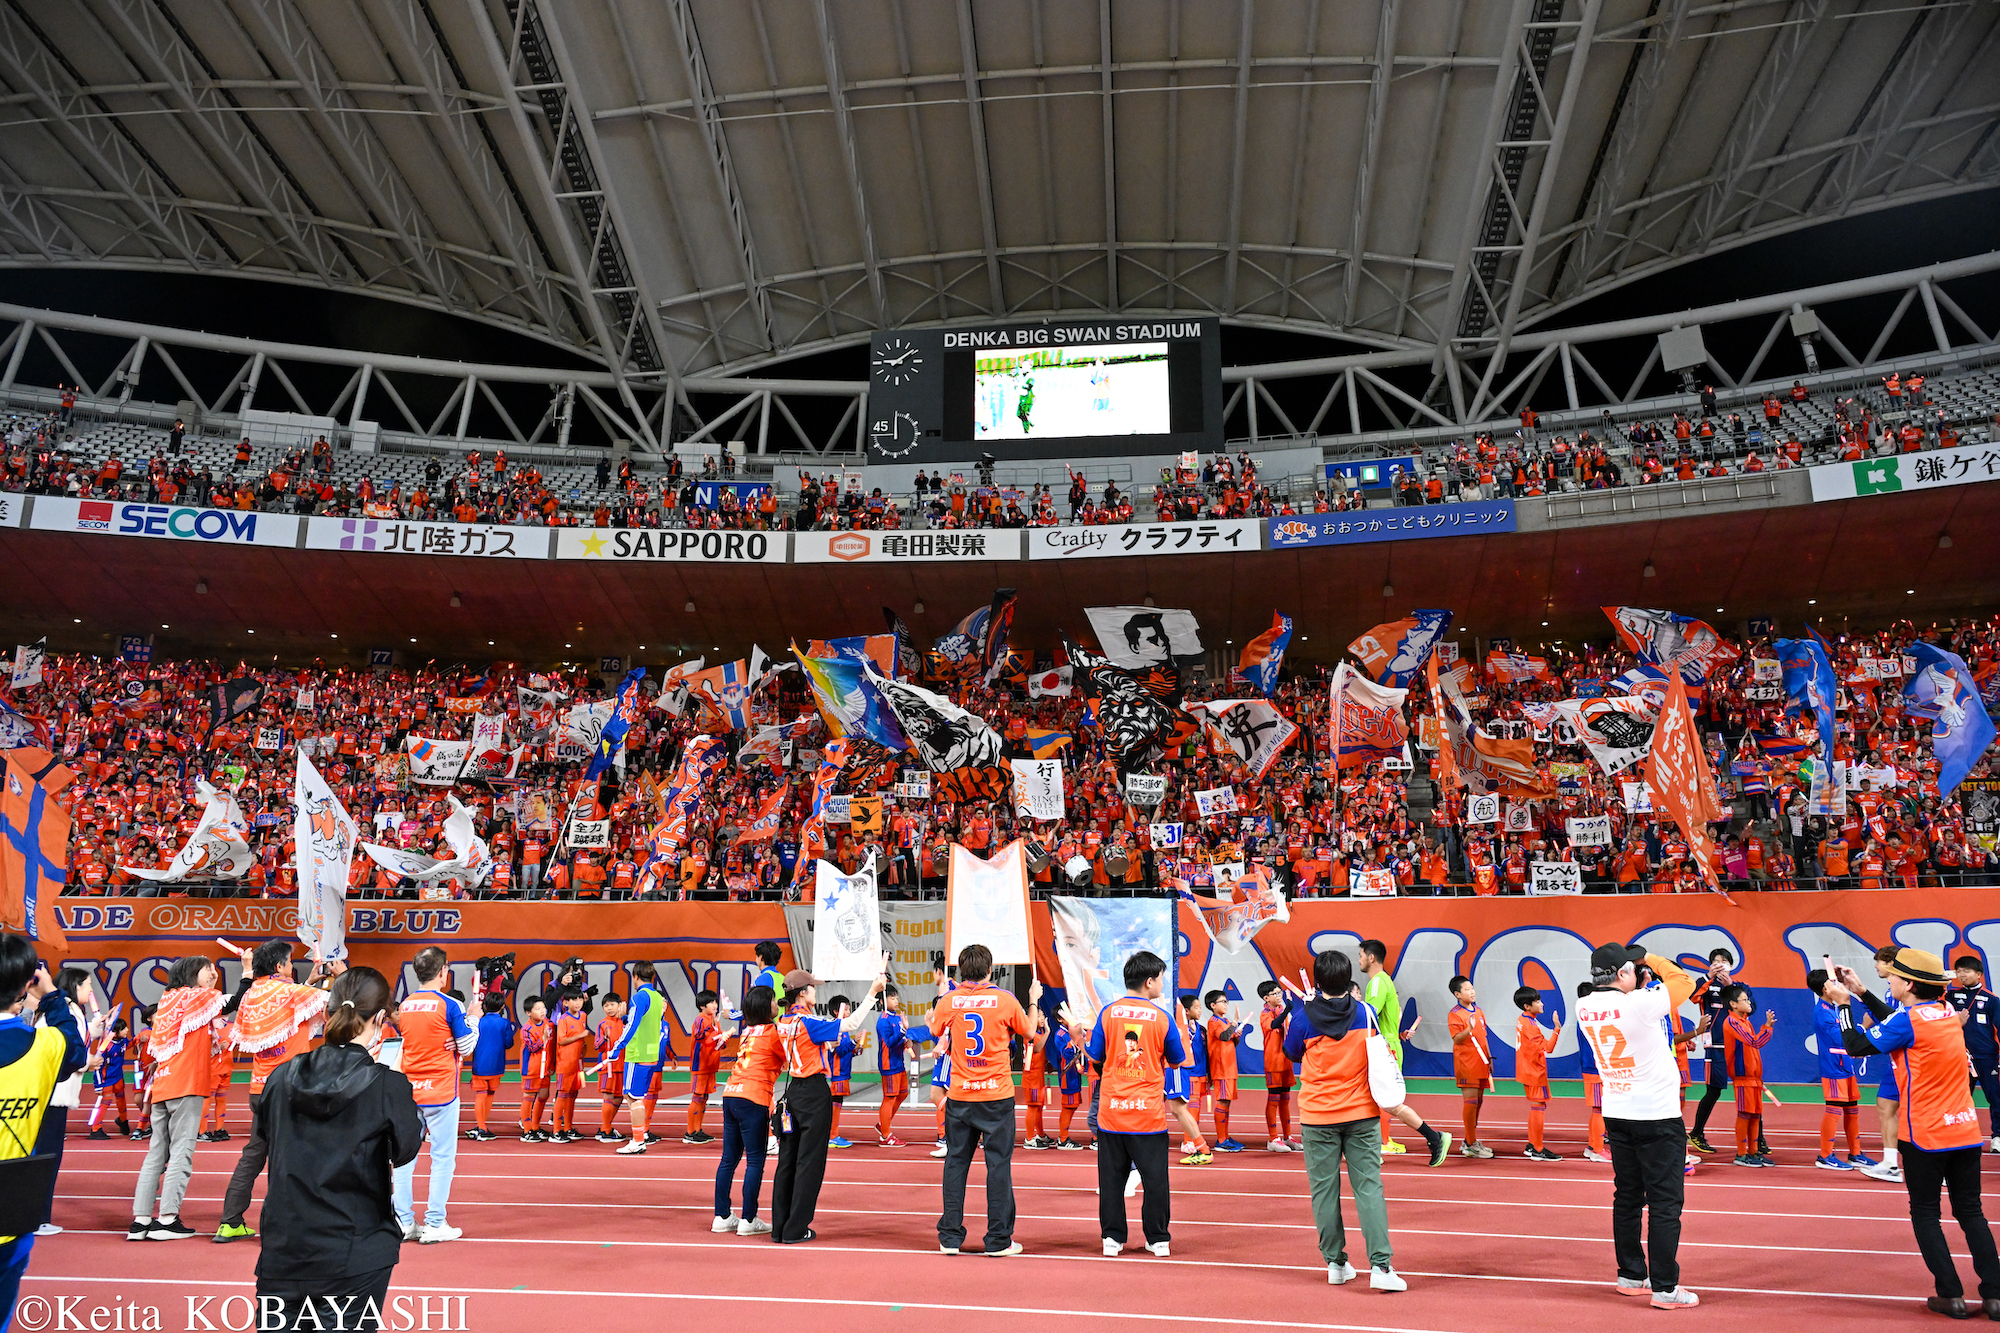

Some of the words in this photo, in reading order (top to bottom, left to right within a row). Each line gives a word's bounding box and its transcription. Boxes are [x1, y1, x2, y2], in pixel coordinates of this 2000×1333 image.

[944, 330, 1011, 348] DENKA
[1015, 329, 1049, 345] BIG
[1053, 326, 1111, 343] SWAN
[1115, 322, 1201, 340] STADIUM
[872, 420, 889, 432] 45
[694, 486, 712, 505] N
[78, 520, 109, 529] SECOM
[119, 504, 257, 542] SECOM
[1322, 508, 1508, 535] おおつかこどもクリニック
[383, 524, 516, 556] 北陸ガス
[1046, 530, 1108, 551] Crafty
[1119, 525, 1243, 551] クラフティ
[613, 531, 768, 560] SAPPORO
[882, 534, 986, 557] 亀田製菓
[1750, 621, 1770, 634] 71
[1491, 641, 1511, 652] 72
[373, 651, 391, 663] 77
[602, 659, 620, 669] 76
[1881, 663, 1896, 673] 31
[539, 709, 553, 723] 12
[260, 730, 279, 742] 45
[477, 721, 500, 741] 絆
[557, 744, 587, 757] LOVE
[1608, 745, 1652, 772] NIIG
[919, 772, 928, 780] 45
[1036, 762, 1055, 796] 行こう
[1015, 770, 1033, 816] この先へ
[1960, 781, 1978, 792] GET
[1985, 781, 2000, 792] TO
[1031, 794, 1062, 803] SINCE
[1476, 801, 1494, 816] 航
[573, 822, 602, 834] 全力
[1574, 819, 1607, 830] つかめ
[1964, 816, 1974, 832] 5
[573, 833, 604, 845] 蹴球
[1164, 824, 1182, 844] 31
[1575, 831, 1605, 844] 勝利
[1275, 855, 1286, 867] 5
[1532, 864, 1577, 876] てっぺん
[1351, 872, 1361, 889] 7
[1535, 878, 1578, 892] 獲るぞ!
[52, 905, 136, 932] ADE
[149, 903, 300, 934] ORANG
[350, 907, 463, 935] BLUE
[895, 918, 945, 938] fight
[896, 949, 927, 964] run
[896, 971, 936, 986] sho
[1179, 922, 1746, 1064] AMOS
[1124, 1009, 1156, 1021] コメリ
[1589, 1009, 1621, 1021] コメリ
[963, 1012, 985, 1058] 3
[1584, 1024, 1636, 1070] 12
[966, 1058, 988, 1068] DENG
[1114, 1067, 1147, 1079] TANIGUCHI
